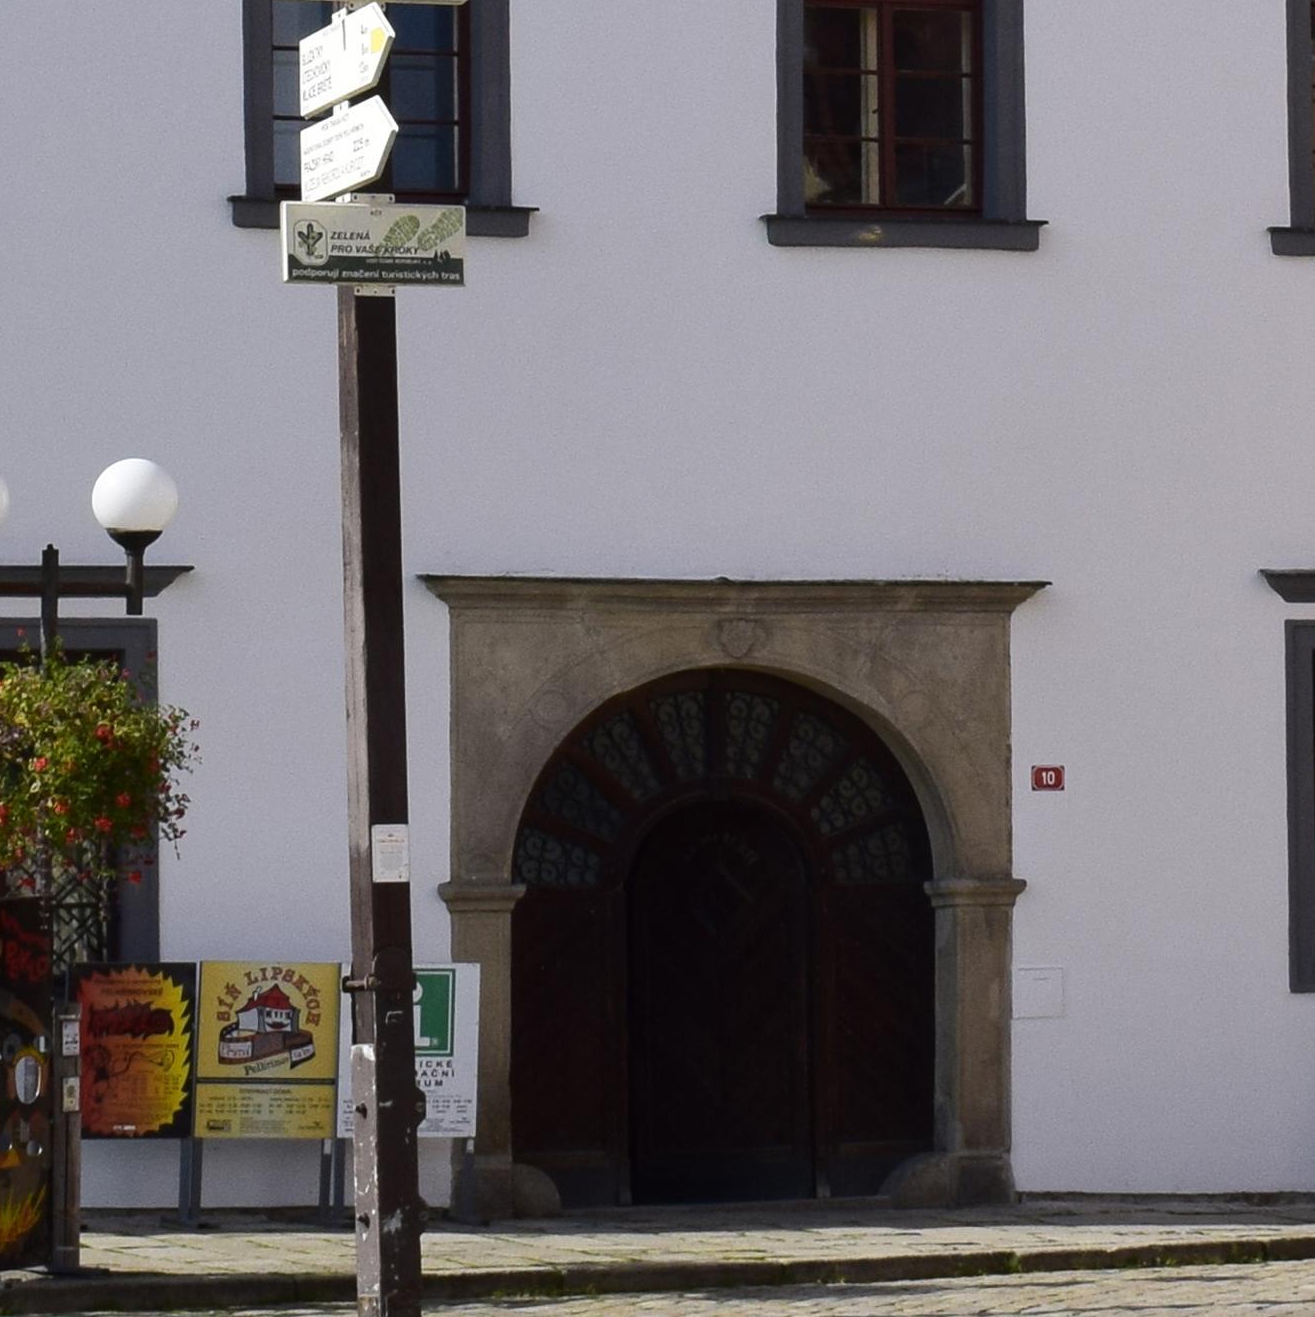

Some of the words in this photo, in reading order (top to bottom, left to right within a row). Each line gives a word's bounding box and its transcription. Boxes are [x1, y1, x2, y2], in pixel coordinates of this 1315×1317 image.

[330, 230, 371, 241] ZELENÁ
[330, 244, 353, 254] PRO
[291, 267, 340, 280] podporují
[341, 268, 380, 279] značení
[381, 269, 439, 281] turistických
[441, 270, 460, 280] tras
[1041, 770, 1056, 785] 10
